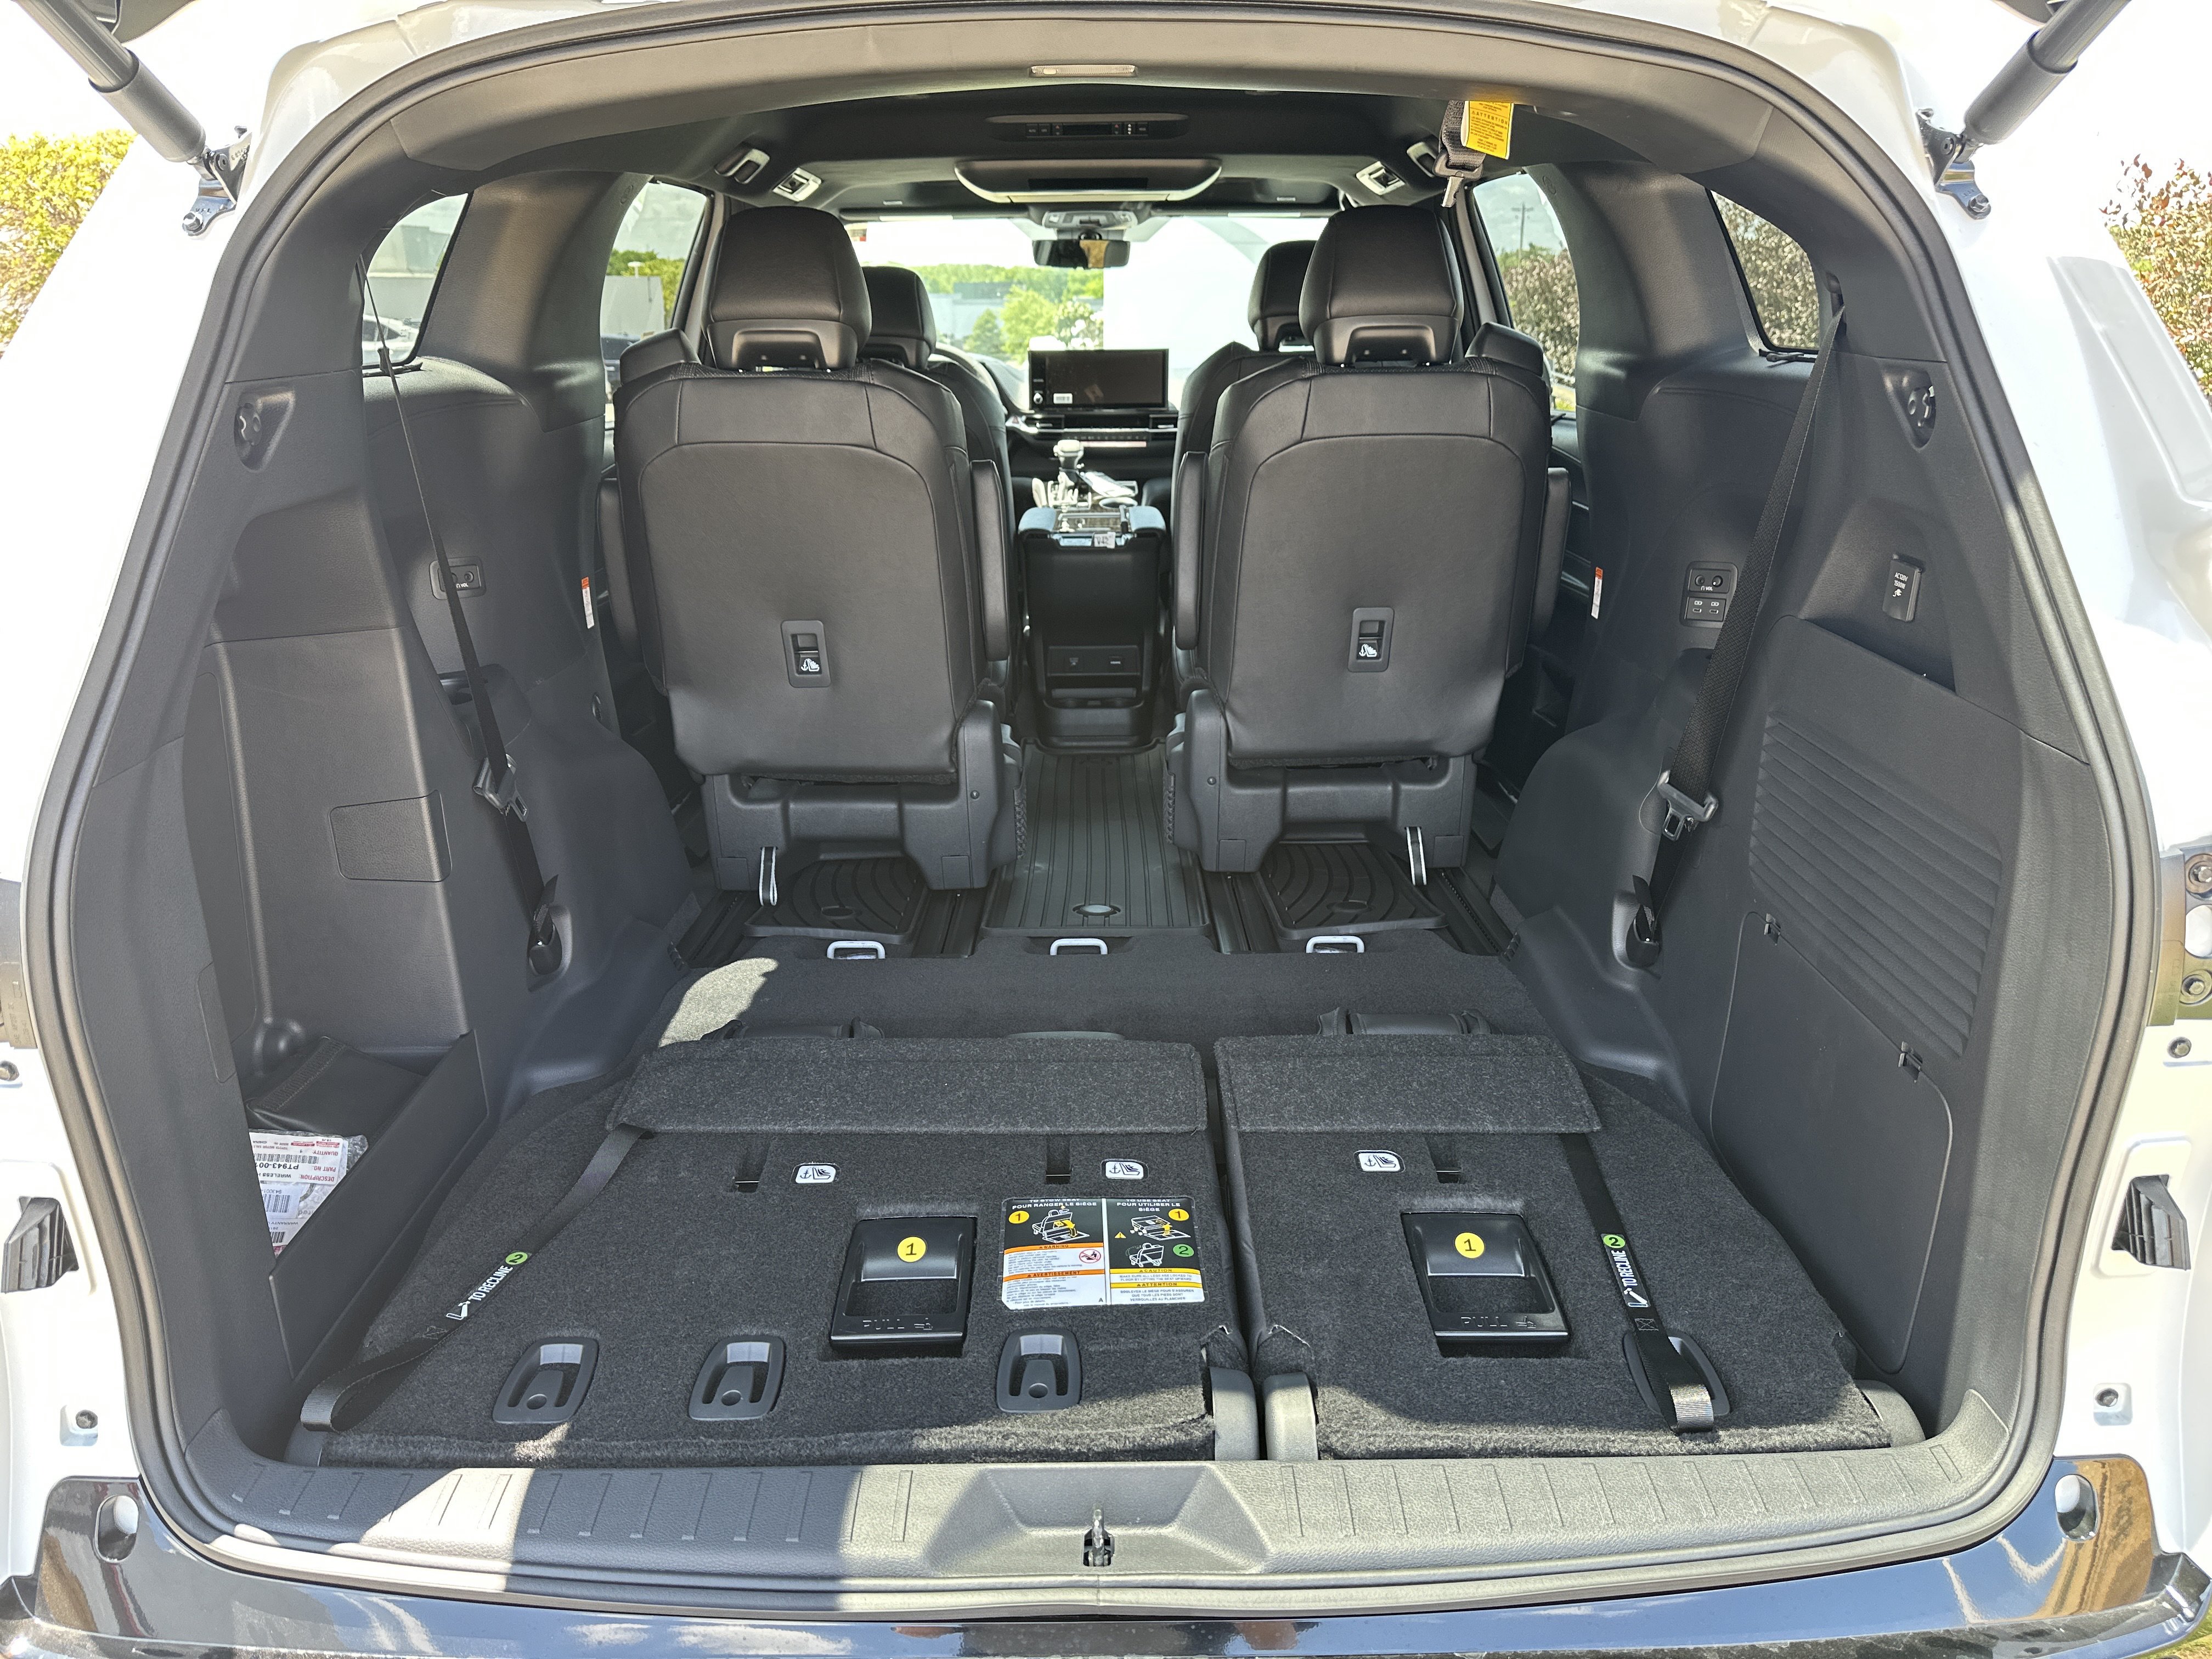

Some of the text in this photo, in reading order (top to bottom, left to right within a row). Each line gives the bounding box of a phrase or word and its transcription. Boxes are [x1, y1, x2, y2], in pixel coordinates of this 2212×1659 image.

[1476, 111, 1508, 125] ATTENTION
[1015, 1213, 1021, 1221] 1
[1464, 1239, 1476, 1251] 1
[1609, 1237, 1621, 1246] 2
[905, 1243, 917, 1256] 1
[1178, 1246, 1189, 1255] 2
[1611, 1250, 1638, 1287] TO RECLINE
[468, 1254, 523, 1301] TO RECLINE 2
[862, 1319, 905, 1330] PULL
[1460, 1316, 1508, 1327] PULL
